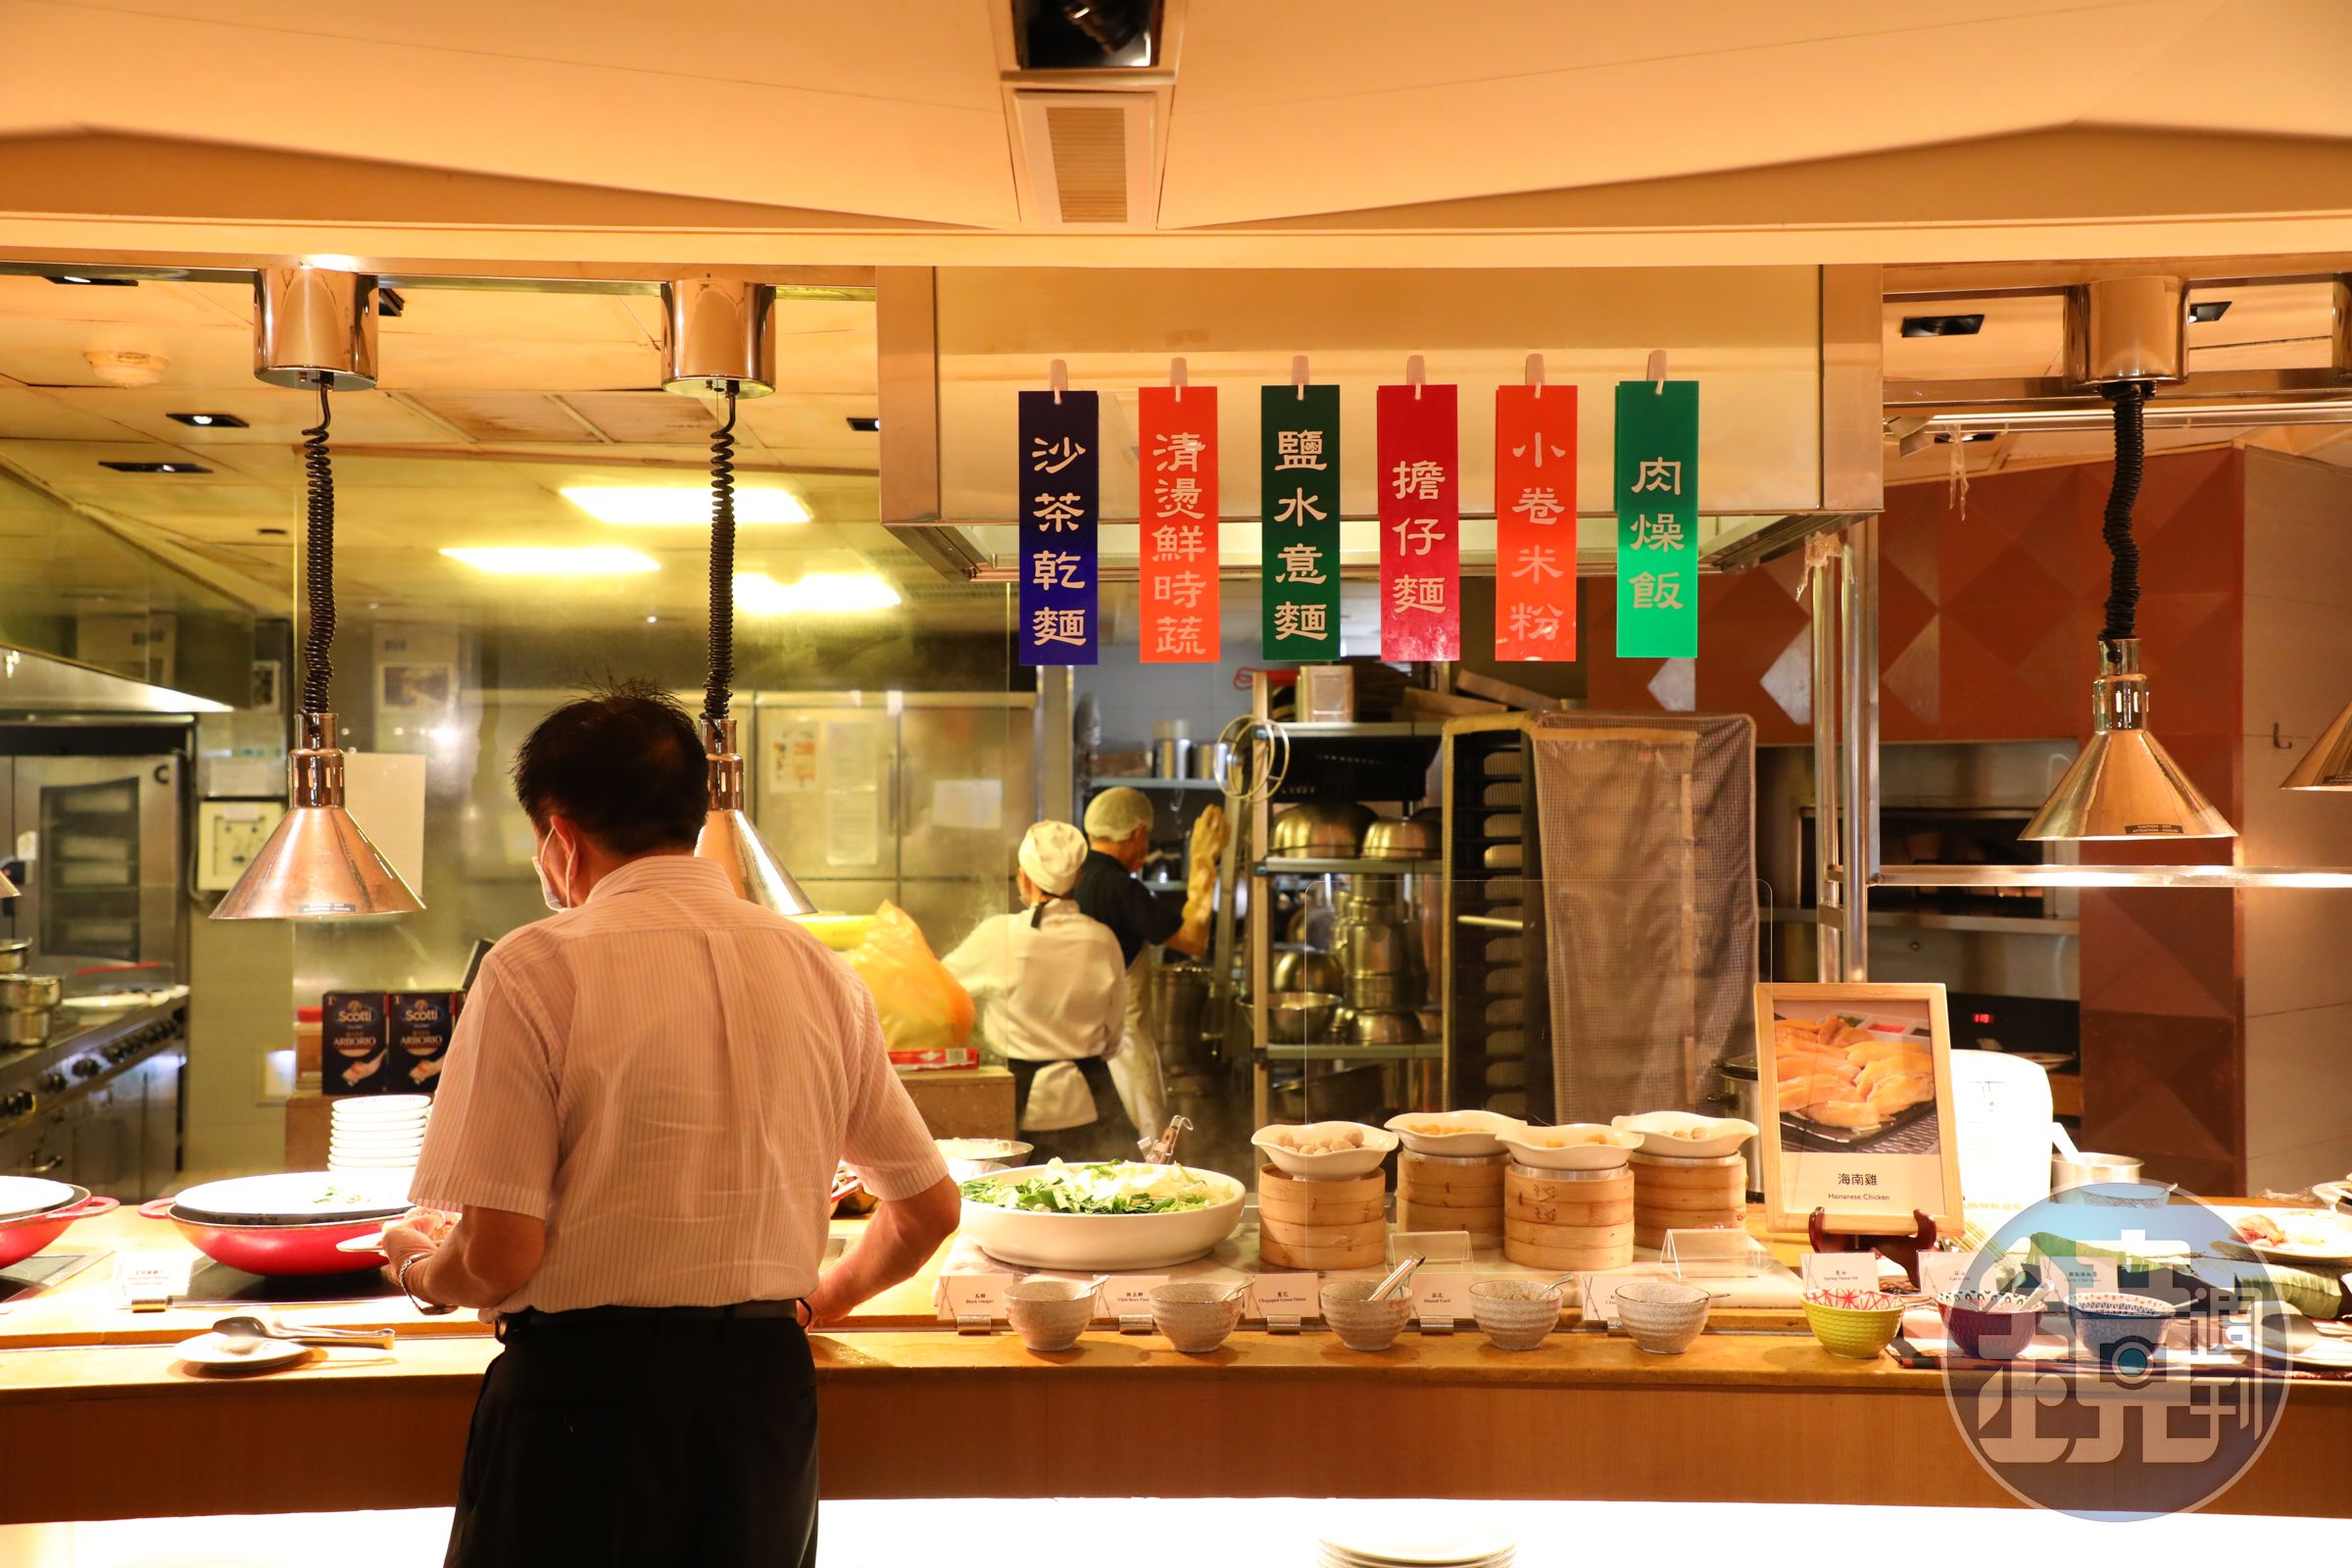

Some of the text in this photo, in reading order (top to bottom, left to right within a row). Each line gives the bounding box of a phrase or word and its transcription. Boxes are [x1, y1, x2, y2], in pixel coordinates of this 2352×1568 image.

[1032, 436, 1087, 648] 沙茶乾麵
[1151, 431, 1207, 656] 清燙鮮時蔬
[1274, 429, 1329, 642] 鹽水意麵
[1391, 459, 1447, 615] 擔仔麵
[1508, 431, 1566, 643] 小卷米粉
[1628, 456, 1686, 612] 肉燥飯
[338, 1010, 371, 1023] Scotti
[405, 1009, 438, 1021] Scotti
[1838, 1173, 1879, 1186] 海南雞
